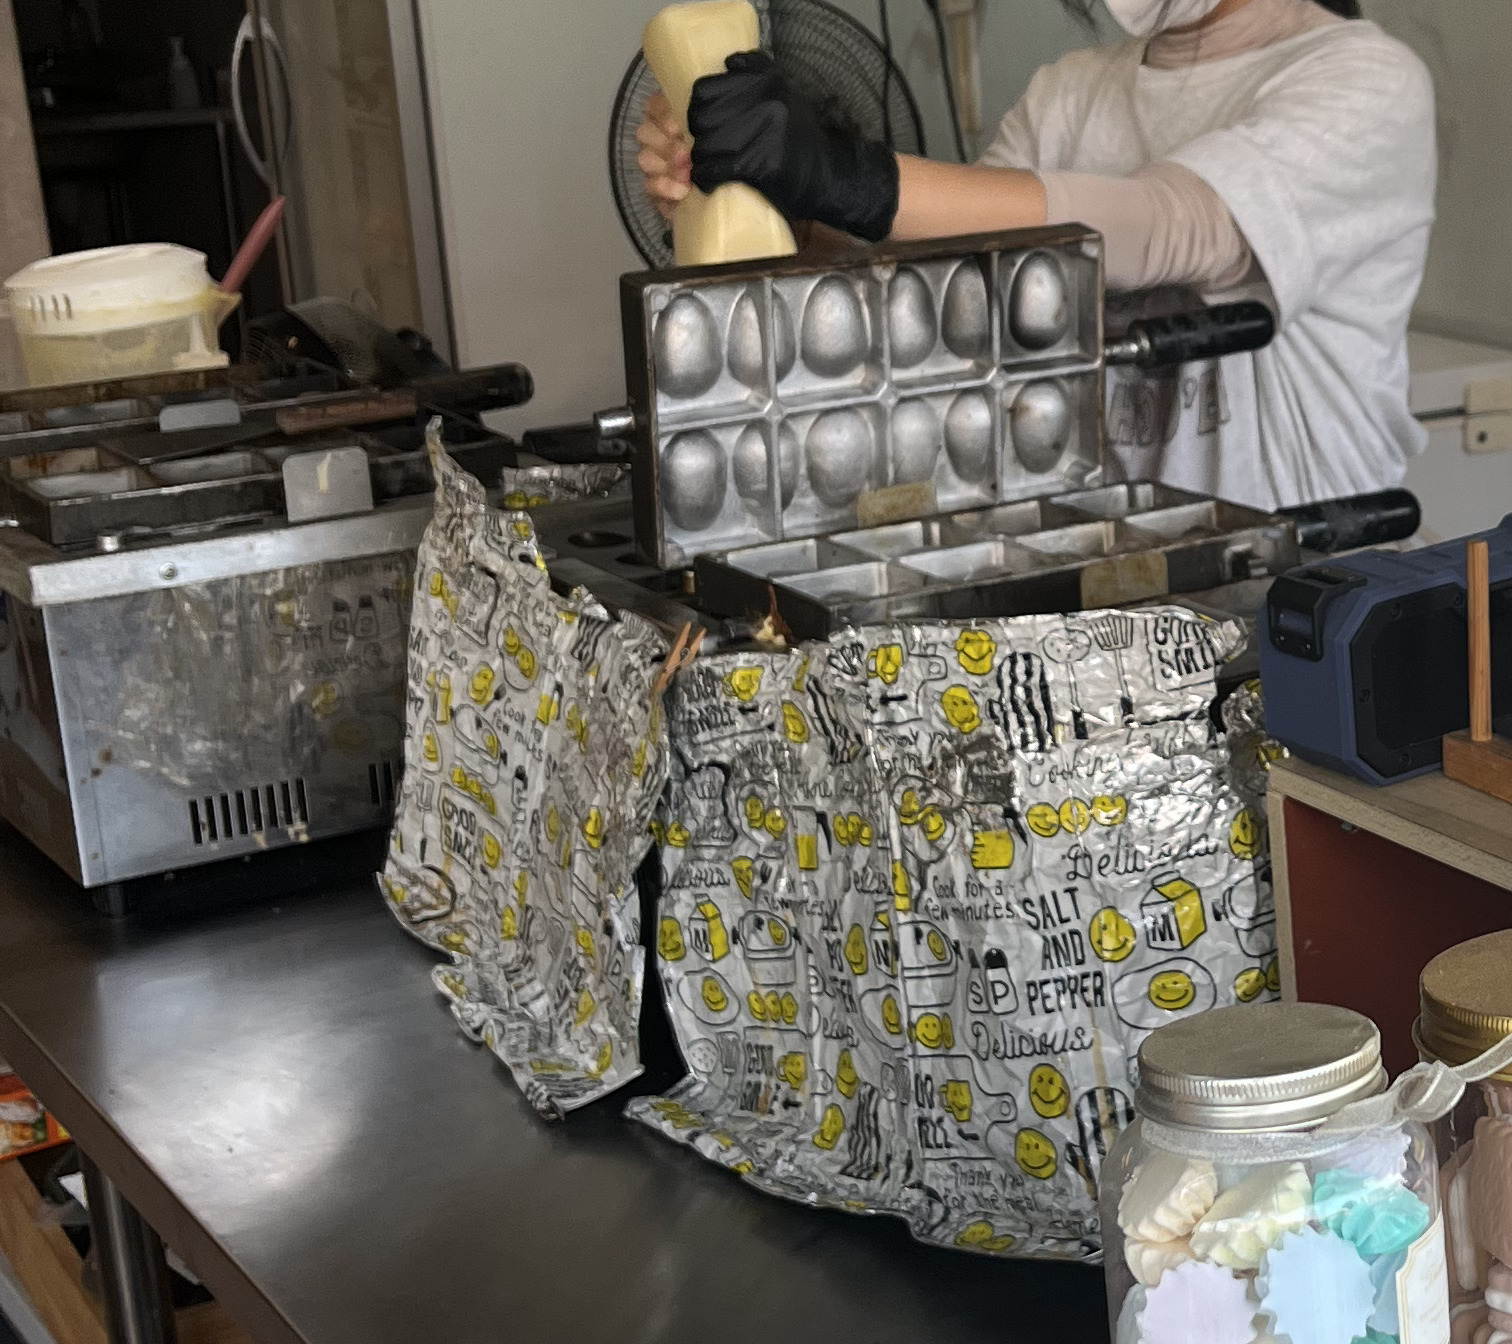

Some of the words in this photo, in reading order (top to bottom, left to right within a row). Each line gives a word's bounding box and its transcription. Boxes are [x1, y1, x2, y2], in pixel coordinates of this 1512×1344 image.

[1023, 886, 1082, 930] SALT
[1041, 929, 1086, 971] AND
[968, 980, 984, 1006] S
[990, 979, 1010, 1006] P
[1026, 971, 1106, 1016] PEPPER
[971, 1020, 1094, 1061] Delicious
